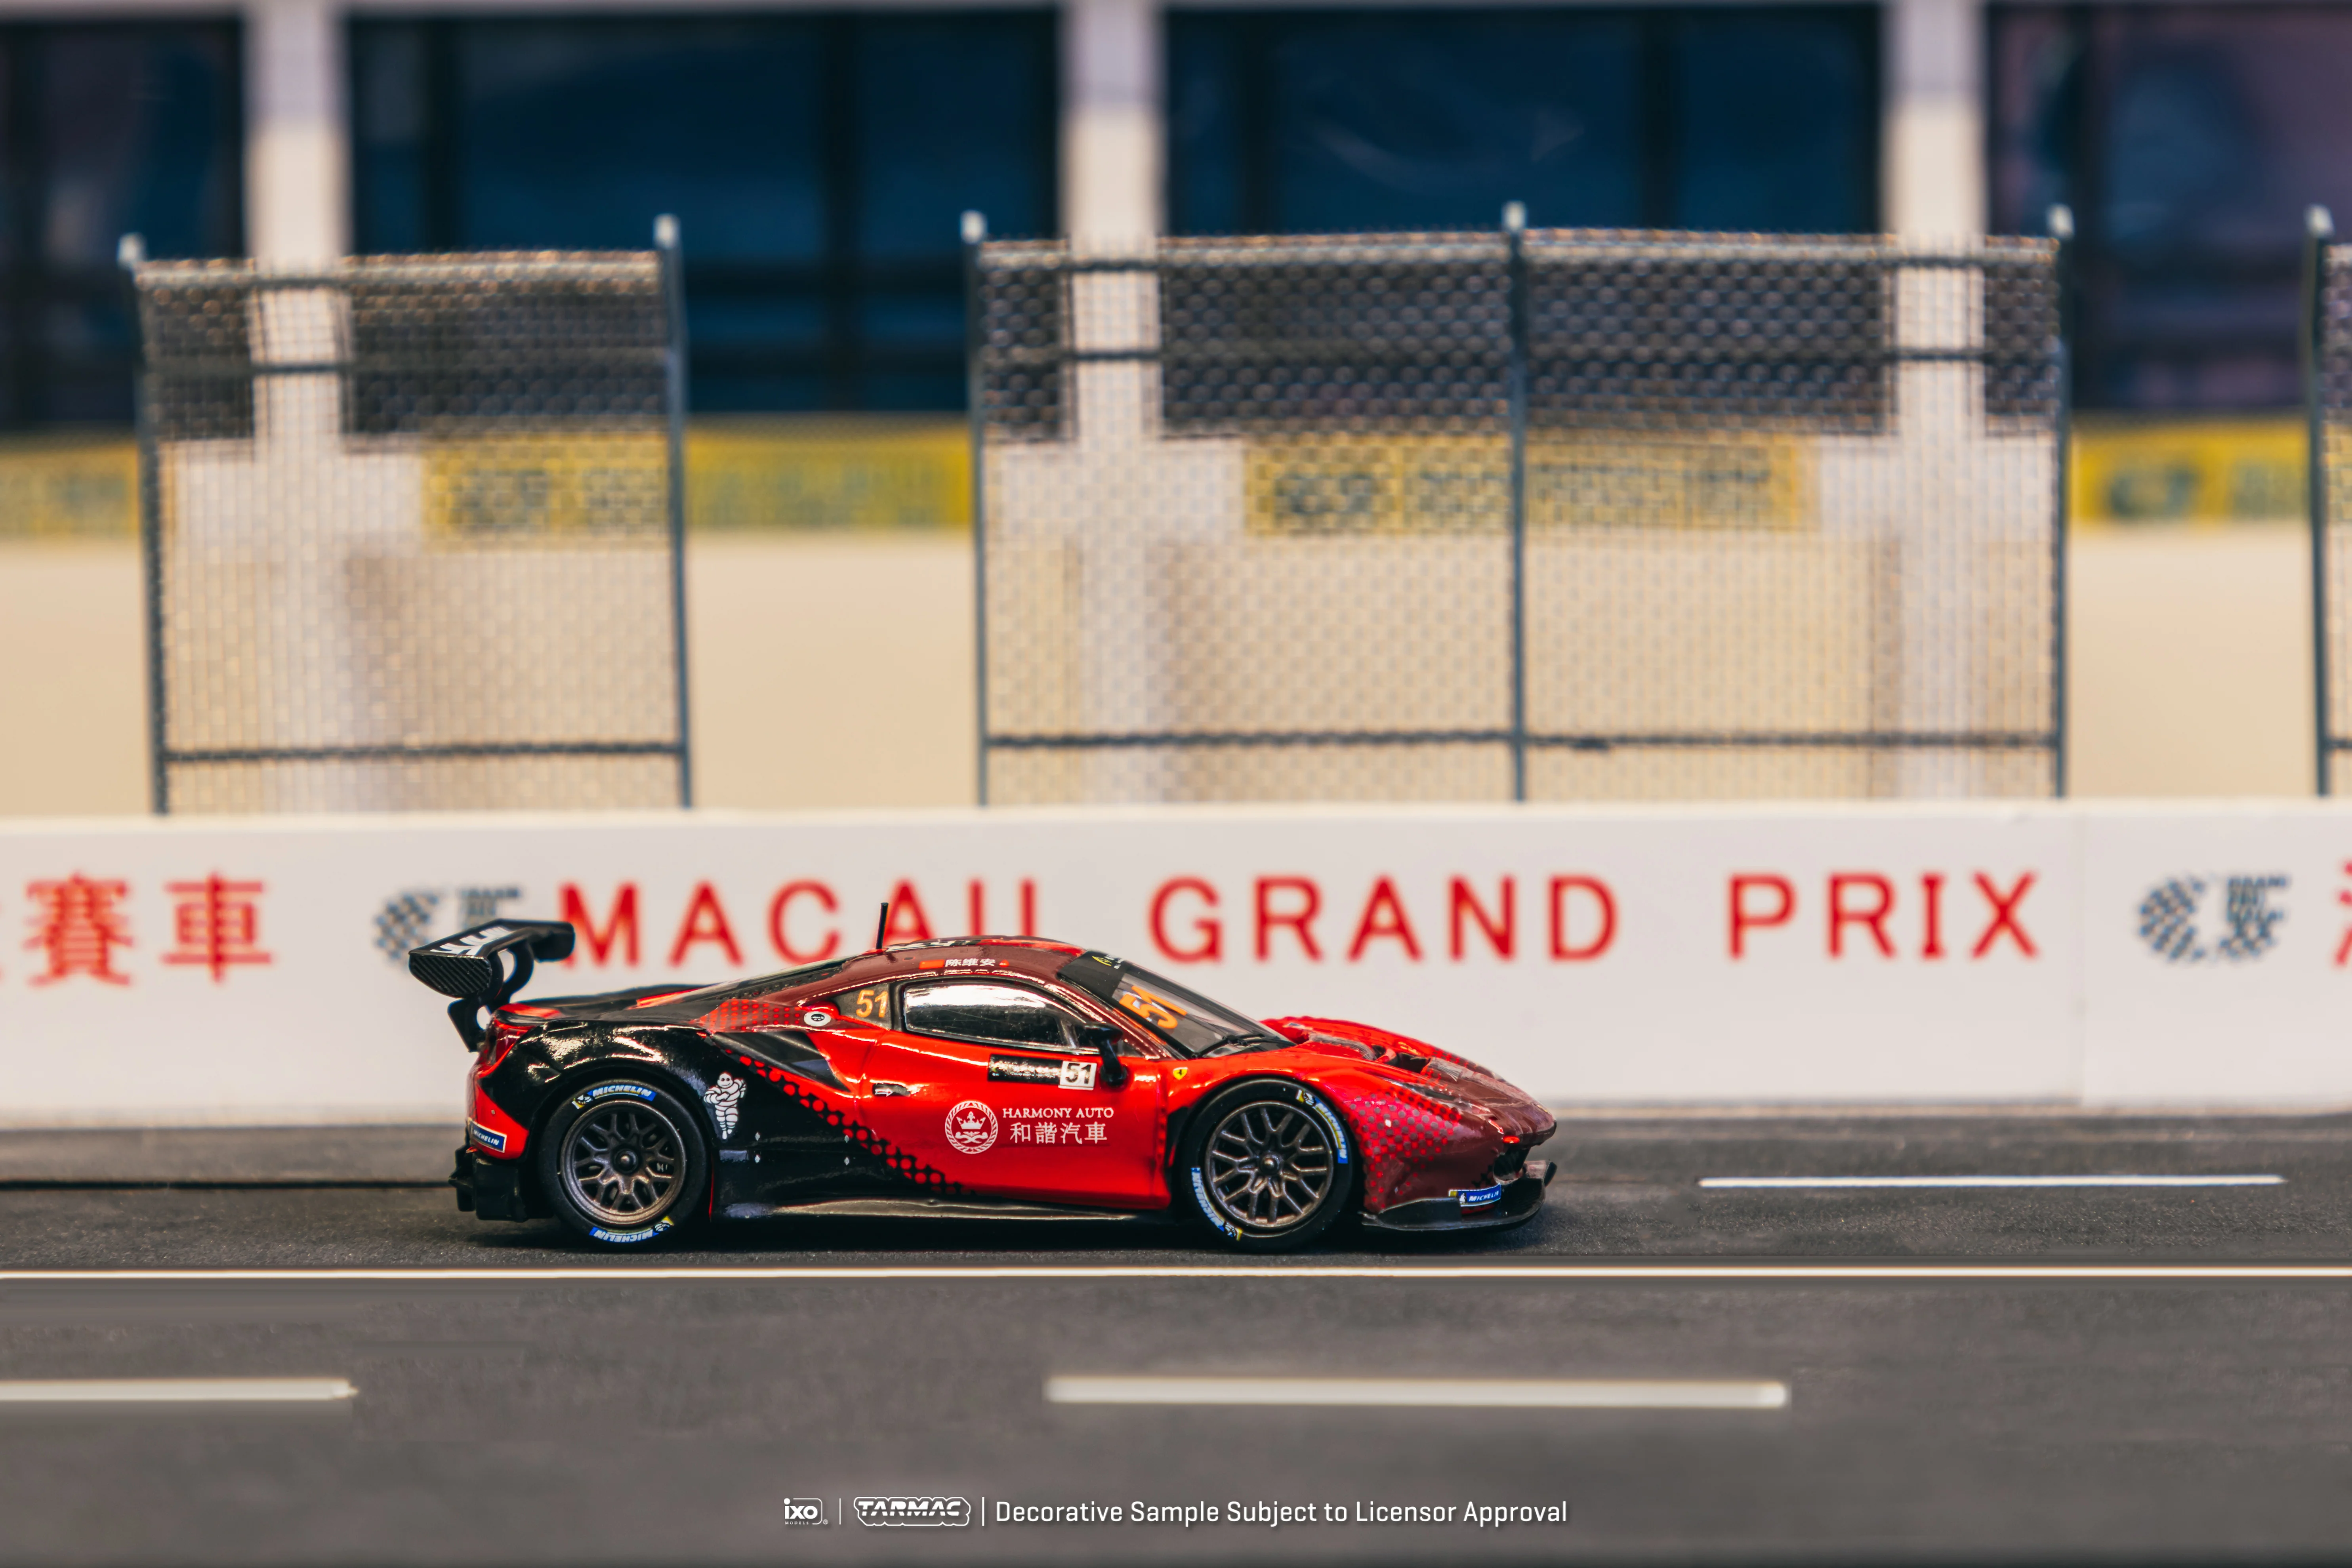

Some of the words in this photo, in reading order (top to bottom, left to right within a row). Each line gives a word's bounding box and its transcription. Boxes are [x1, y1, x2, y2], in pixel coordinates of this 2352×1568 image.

[558, 878, 1038, 969] MACAU
[1147, 874, 1621, 963] GRAND
[1727, 872, 2039, 961] PRIX
[945, 958, 996, 967] 陈维安
[856, 990, 888, 1018] 51
[1119, 986, 1187, 1029] 51
[1065, 1063, 1092, 1084] 51
[592, 1085, 652, 1097] MICHELIN
[1003, 1108, 1072, 1118] HARMONY
[1076, 1108, 1114, 1118] AUTO
[473, 1129, 500, 1146] MICHELIN
[1010, 1122, 1108, 1144] 和諧汽車
[1315, 1103, 1347, 1159] MICHELIN
[1191, 1171, 1225, 1227] MICHELIN
[1468, 1190, 1499, 1202] MICHELIN
[593, 1229, 654, 1243] MICHELIN
